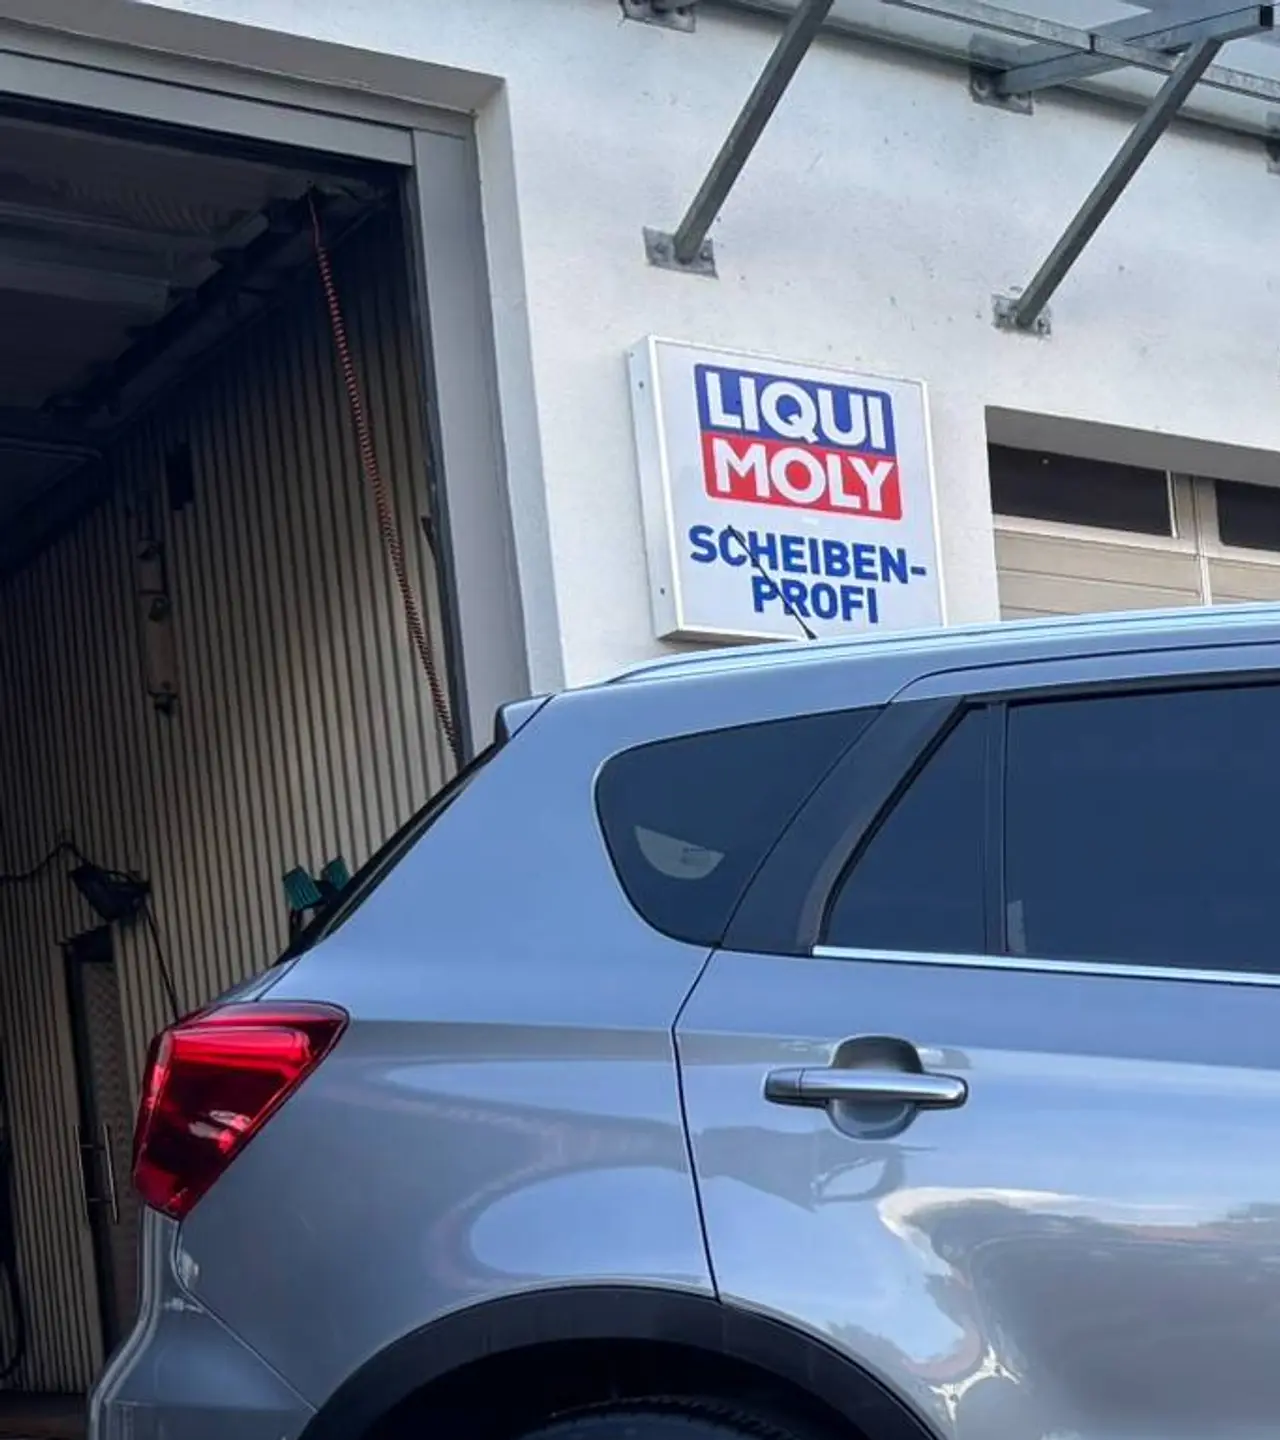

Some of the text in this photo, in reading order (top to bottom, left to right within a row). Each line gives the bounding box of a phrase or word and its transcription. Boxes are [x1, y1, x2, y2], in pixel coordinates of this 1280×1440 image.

[704, 372, 888, 449] LIQUI
[711, 438, 895, 512] MOLY
[688, 524, 927, 584] SCHEIBEN-
[751, 575, 879, 624] PROFI
